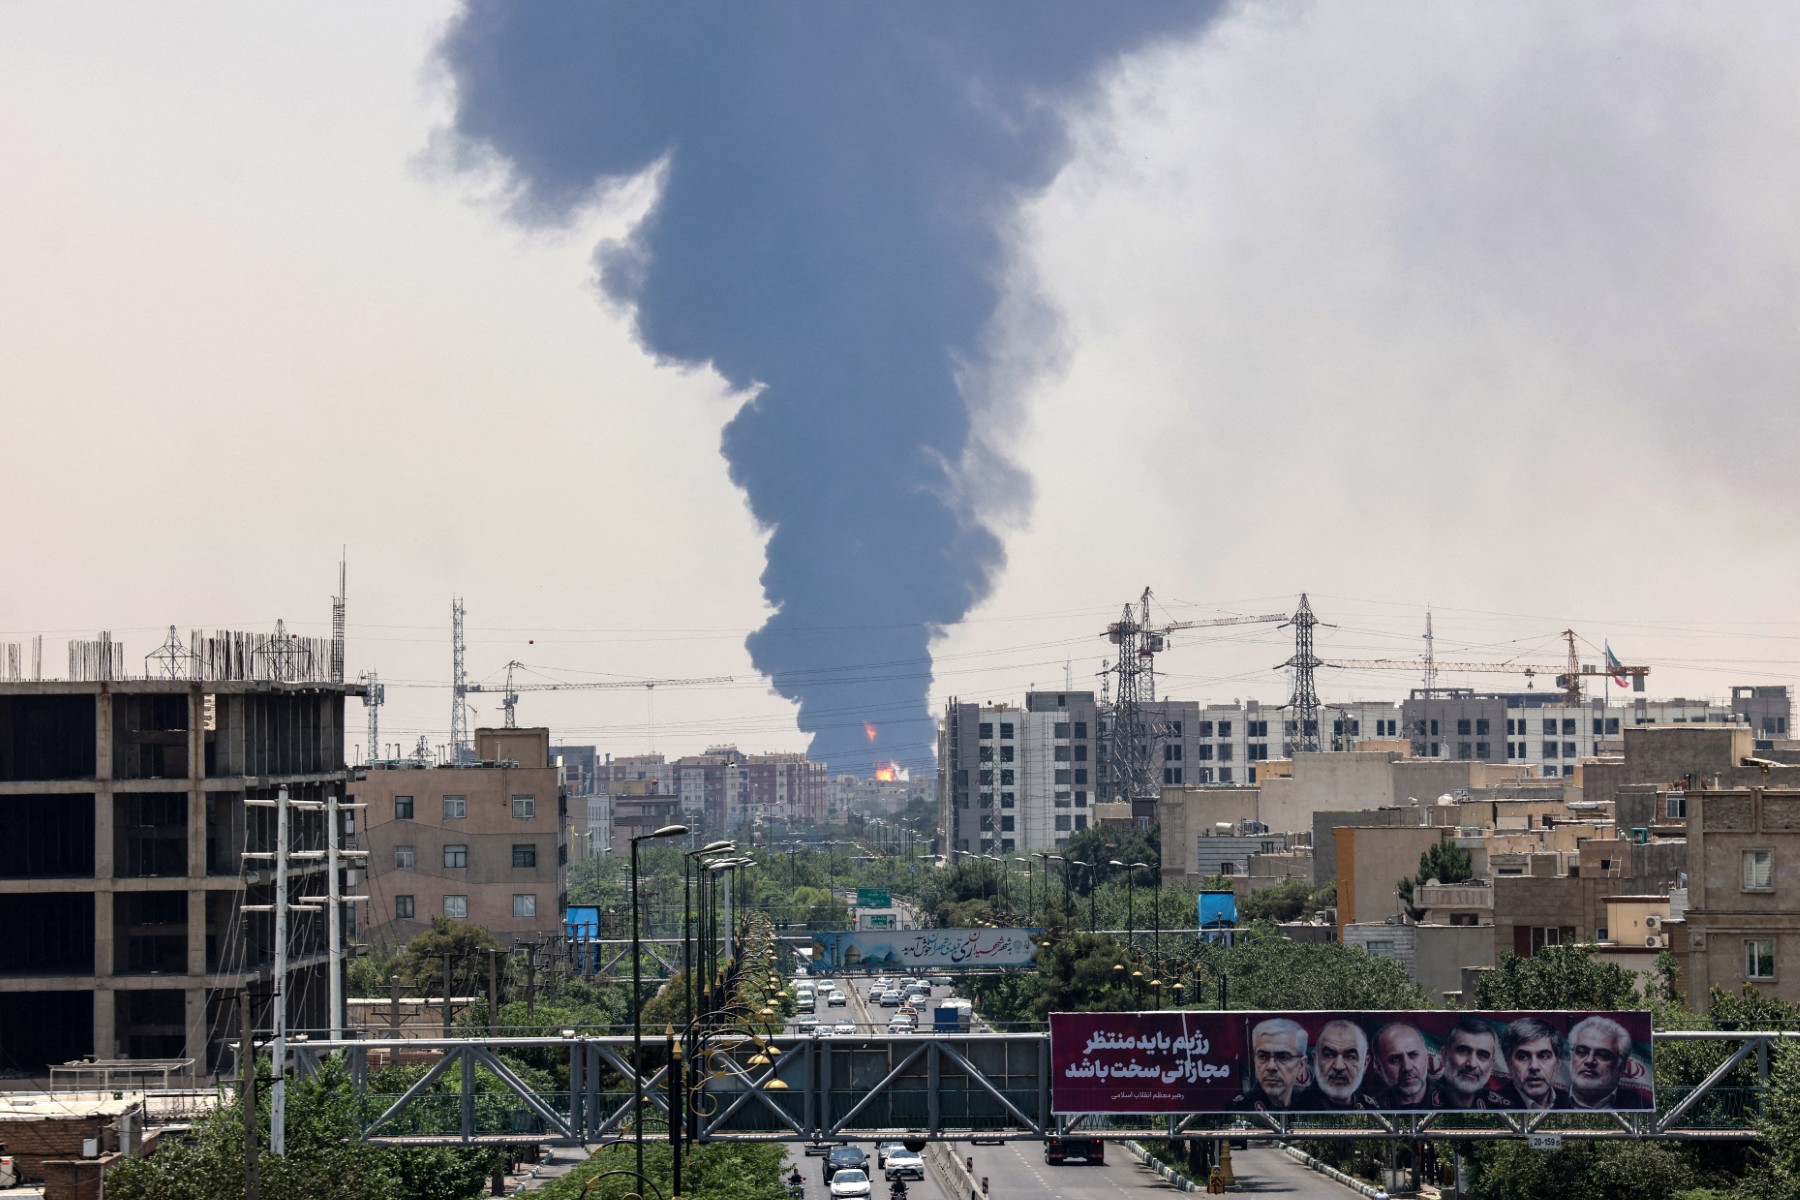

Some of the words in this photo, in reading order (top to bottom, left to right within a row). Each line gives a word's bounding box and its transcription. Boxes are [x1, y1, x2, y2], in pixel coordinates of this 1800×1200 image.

[902, 936, 925, 955] آمدید
[914, 938, 931, 958] خوش
[951, 940, 973, 963] ری
[969, 931, 1005, 958] شهیدان
[991, 937, 1012, 956] شهر
[1082, 1029, 1136, 1055] منتظر
[1136, 1030, 1171, 1056] باید
[1173, 1029, 1210, 1056] رژیم
[1065, 1057, 1110, 1084] باشد
[1110, 1058, 1161, 1079] سخت
[1161, 1058, 1230, 1085] مجازاتی
[1111, 1091, 1134, 1100] اسلامی
[1133, 1091, 1152, 1100] انقلاب
[1152, 1091, 1172, 1100] معظم
[1171, 1091, 1185, 1100] رهبر
[1534, 1138, 1555, 1146] 20-159
